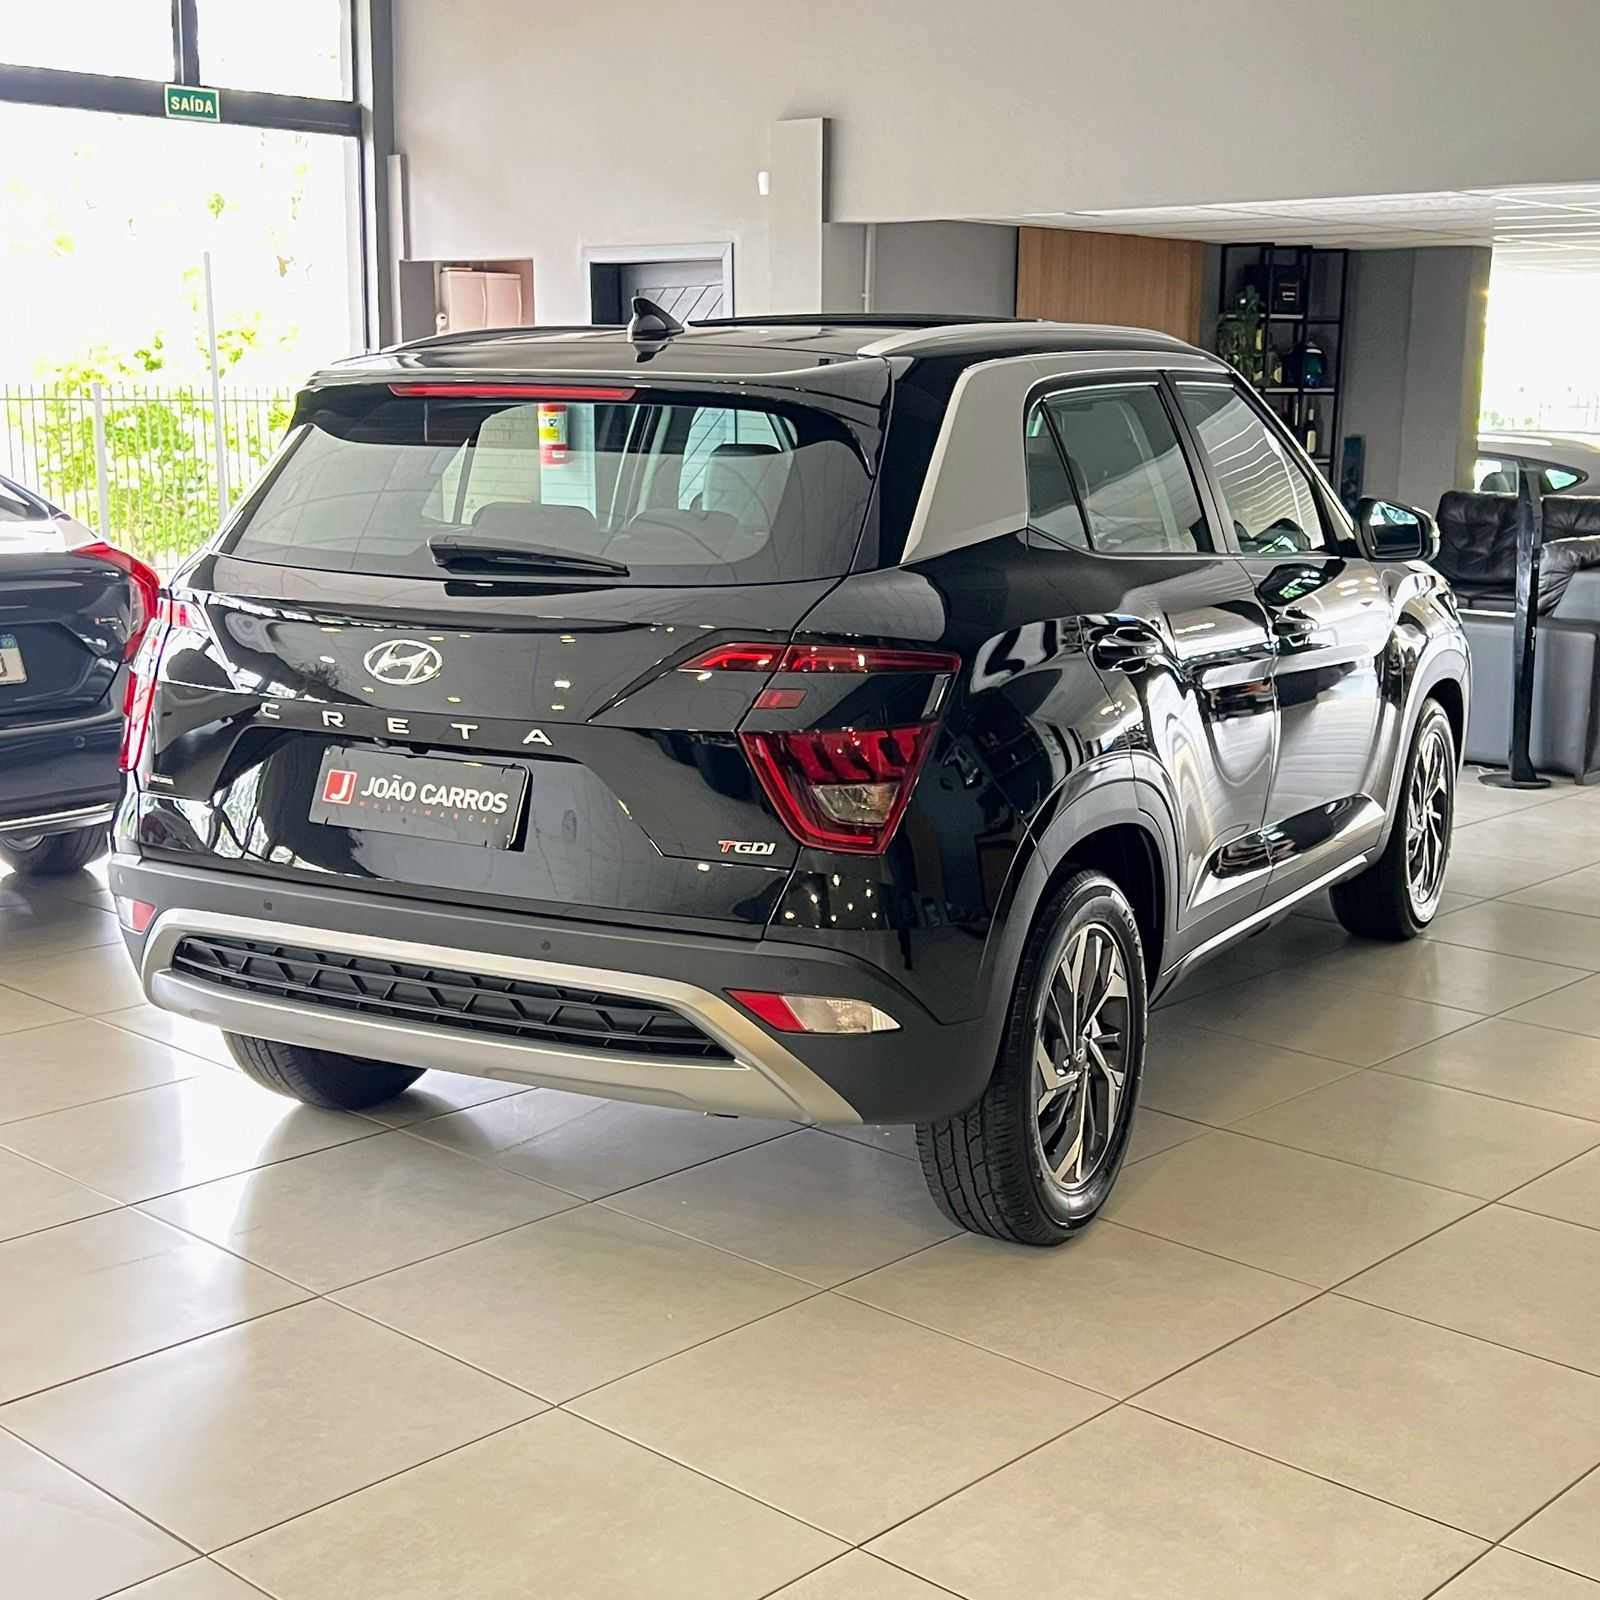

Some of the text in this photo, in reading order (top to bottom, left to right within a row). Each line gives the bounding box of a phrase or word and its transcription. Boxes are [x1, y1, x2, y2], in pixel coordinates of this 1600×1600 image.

[170, 95, 214, 114] SAÍDA
[260, 702, 553, 746] CRETA
[360, 774, 509, 814] JOÃO CARROS
[718, 840, 776, 855] TGDI
